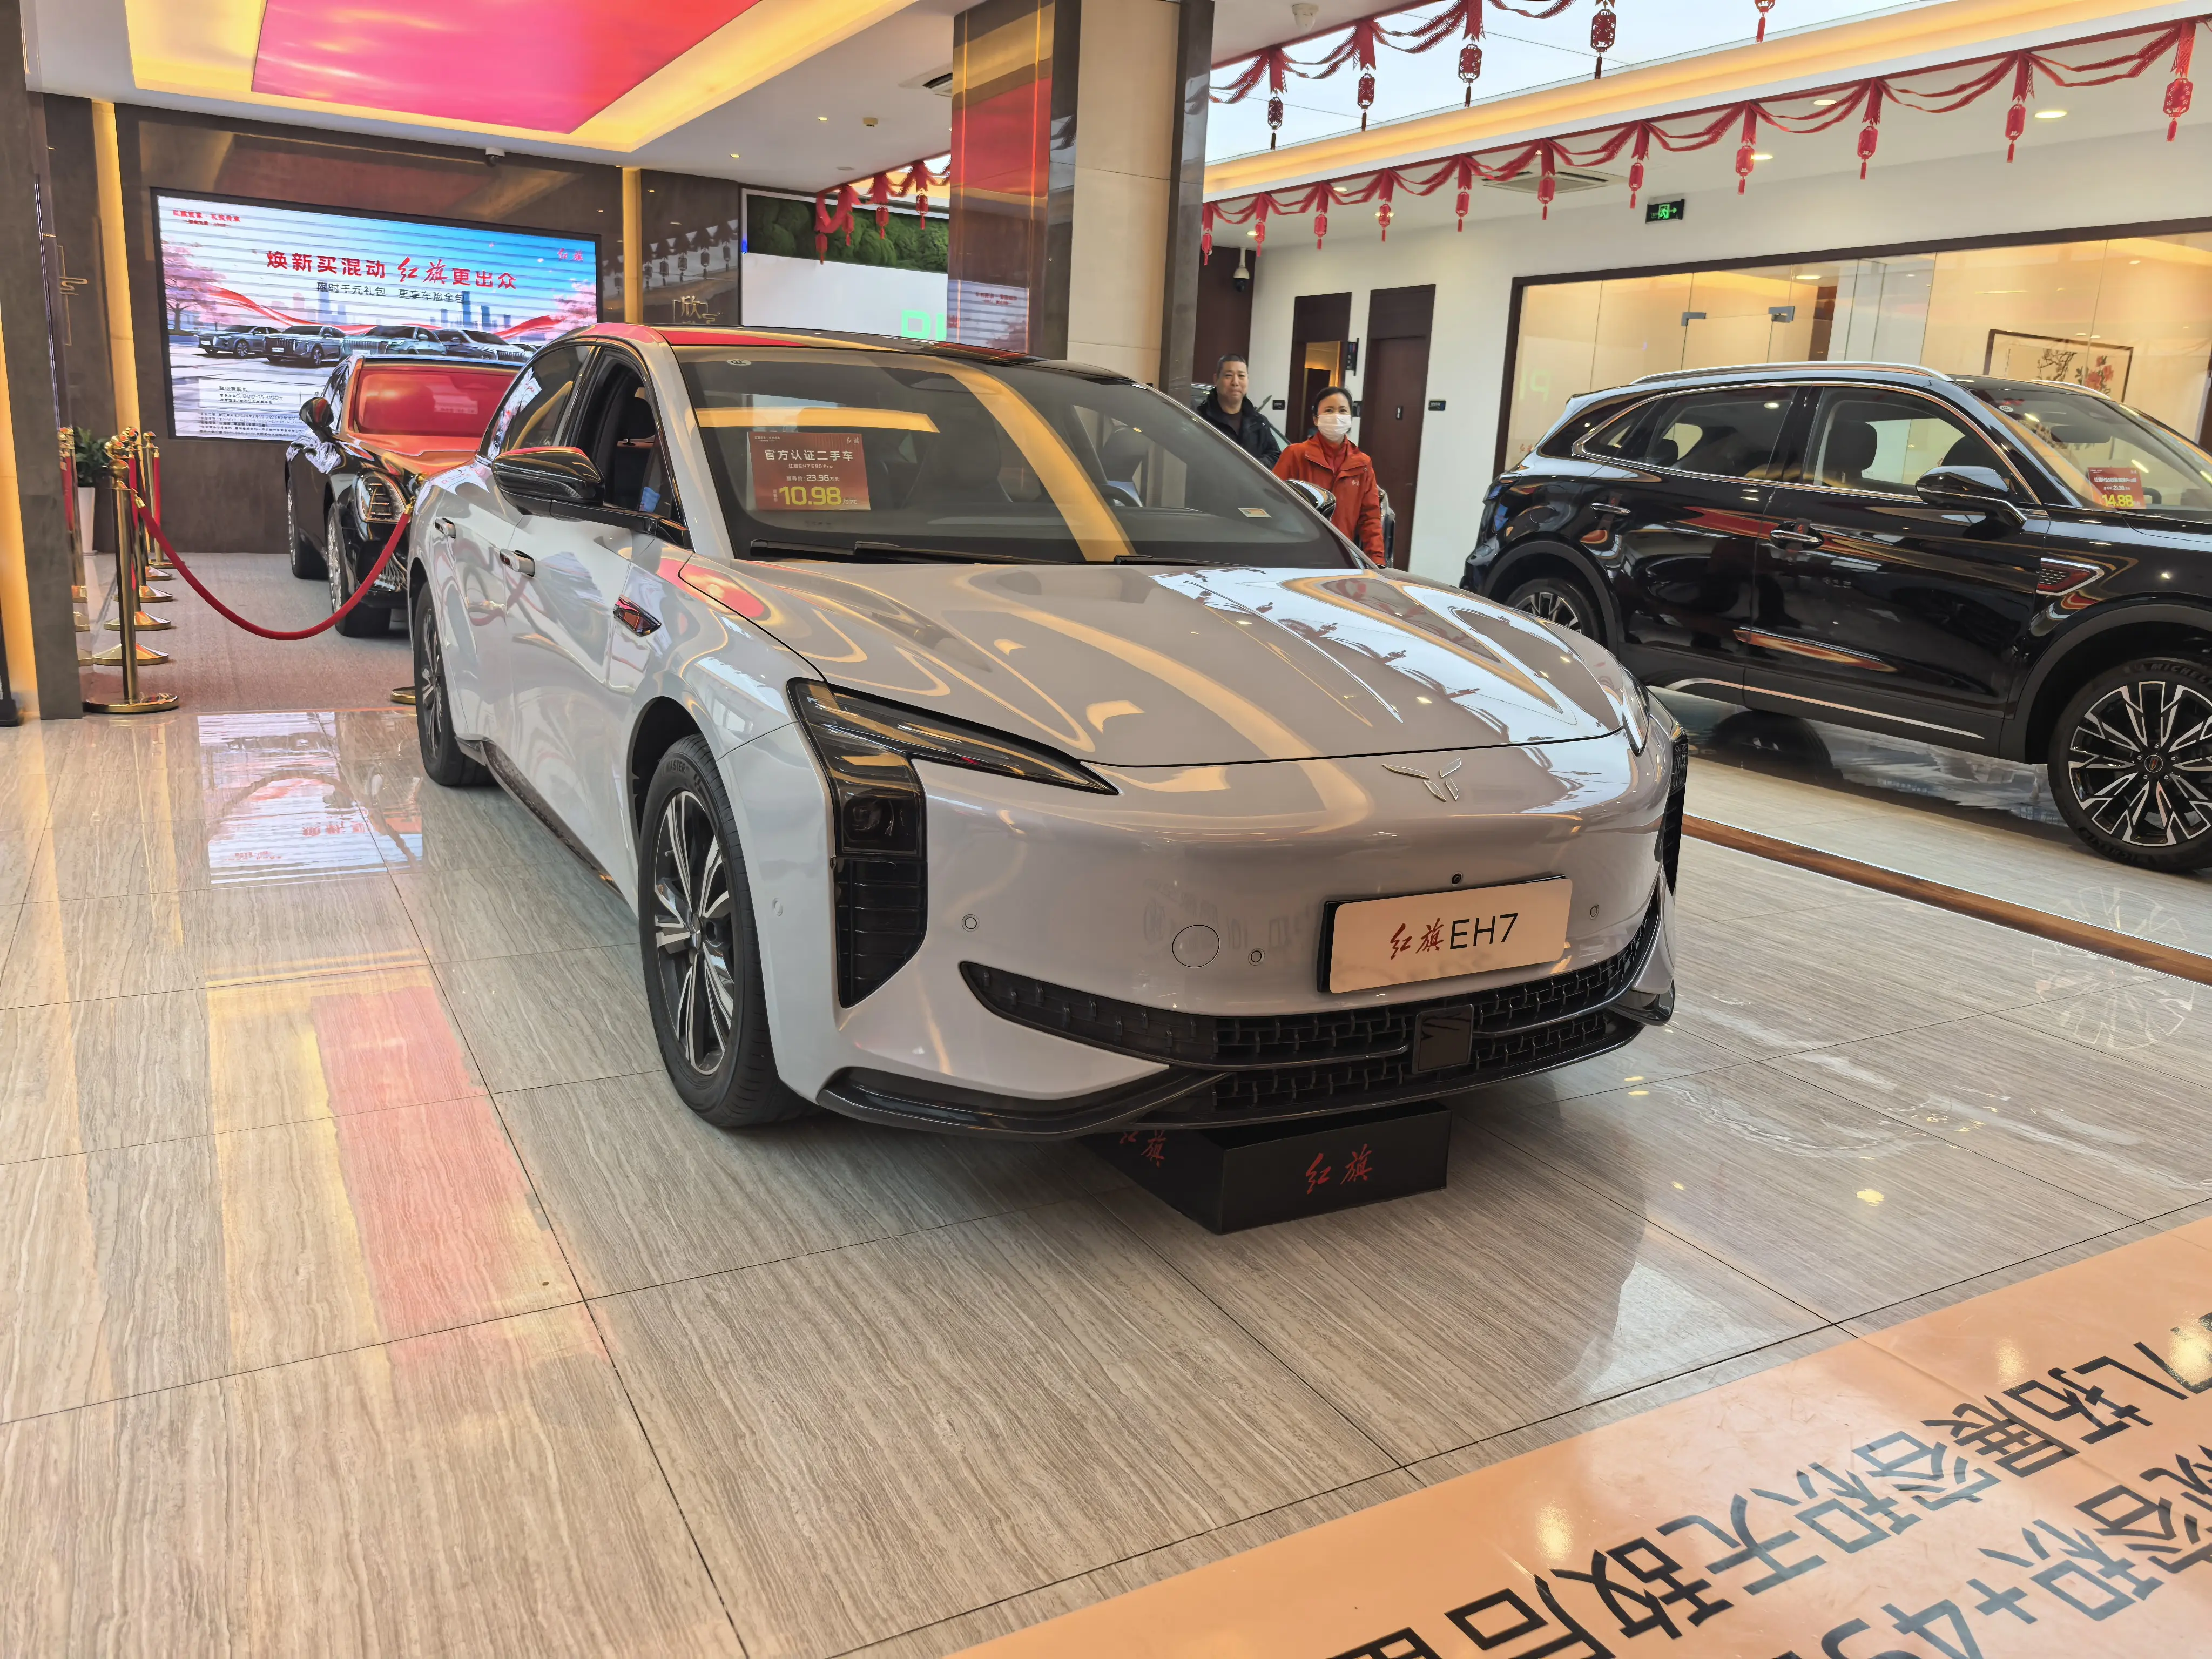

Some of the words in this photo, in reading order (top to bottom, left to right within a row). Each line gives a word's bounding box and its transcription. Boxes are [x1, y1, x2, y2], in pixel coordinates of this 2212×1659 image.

[266, 250, 386, 279] 焕新买混动
[397, 257, 517, 289] 红旗更出众
[316, 281, 386, 297] 限时千元礼包
[765, 449, 854, 461] 官方认证二手车
[1390, 913, 1519, 960] 红旗EH7
[1305, 1143, 1373, 1195] 红旗
